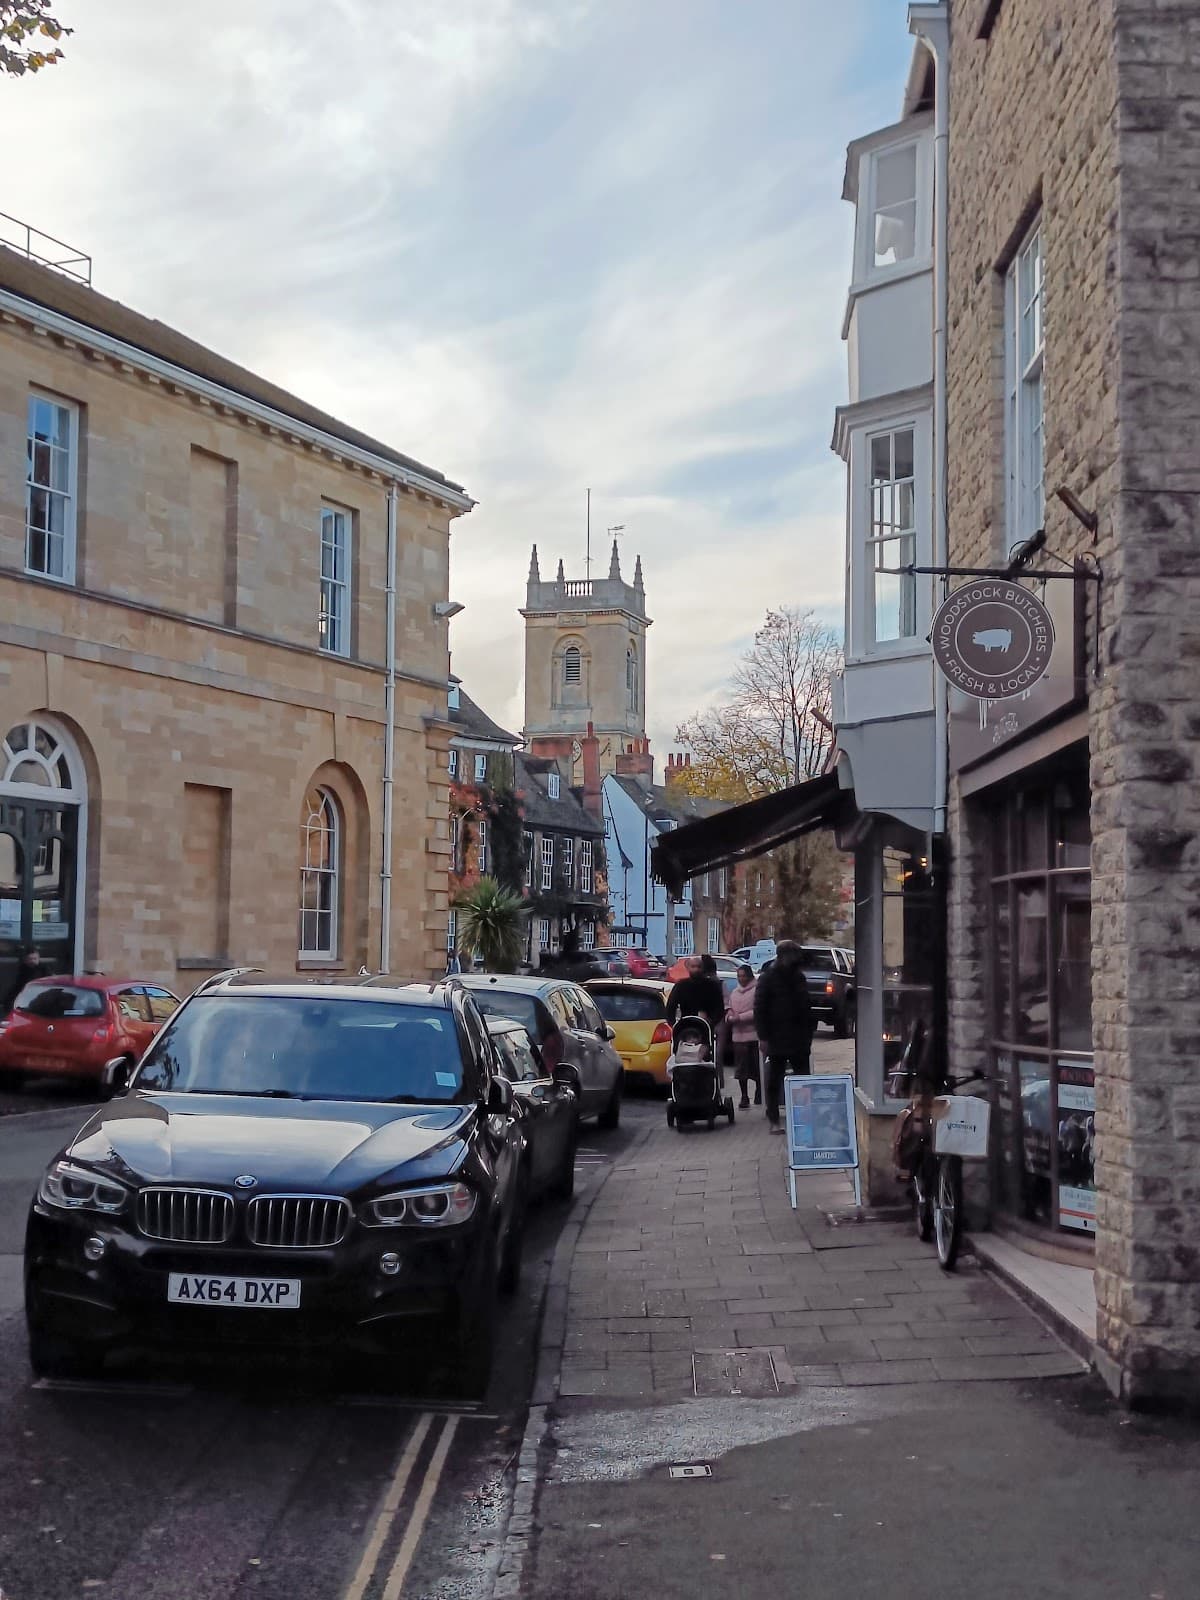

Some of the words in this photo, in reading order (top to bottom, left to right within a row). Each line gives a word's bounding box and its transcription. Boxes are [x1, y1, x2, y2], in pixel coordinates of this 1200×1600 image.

[940, 587, 1001, 650] WOODSTOCK
[1005, 590, 1047, 655] BUTCHERS
[945, 659, 985, 692] FRESH
[987, 684, 996, 693] &
[1000, 665, 1040, 693] LOCAL
[177, 1277, 237, 1302] AX64
[244, 1281, 290, 1304] DXP
